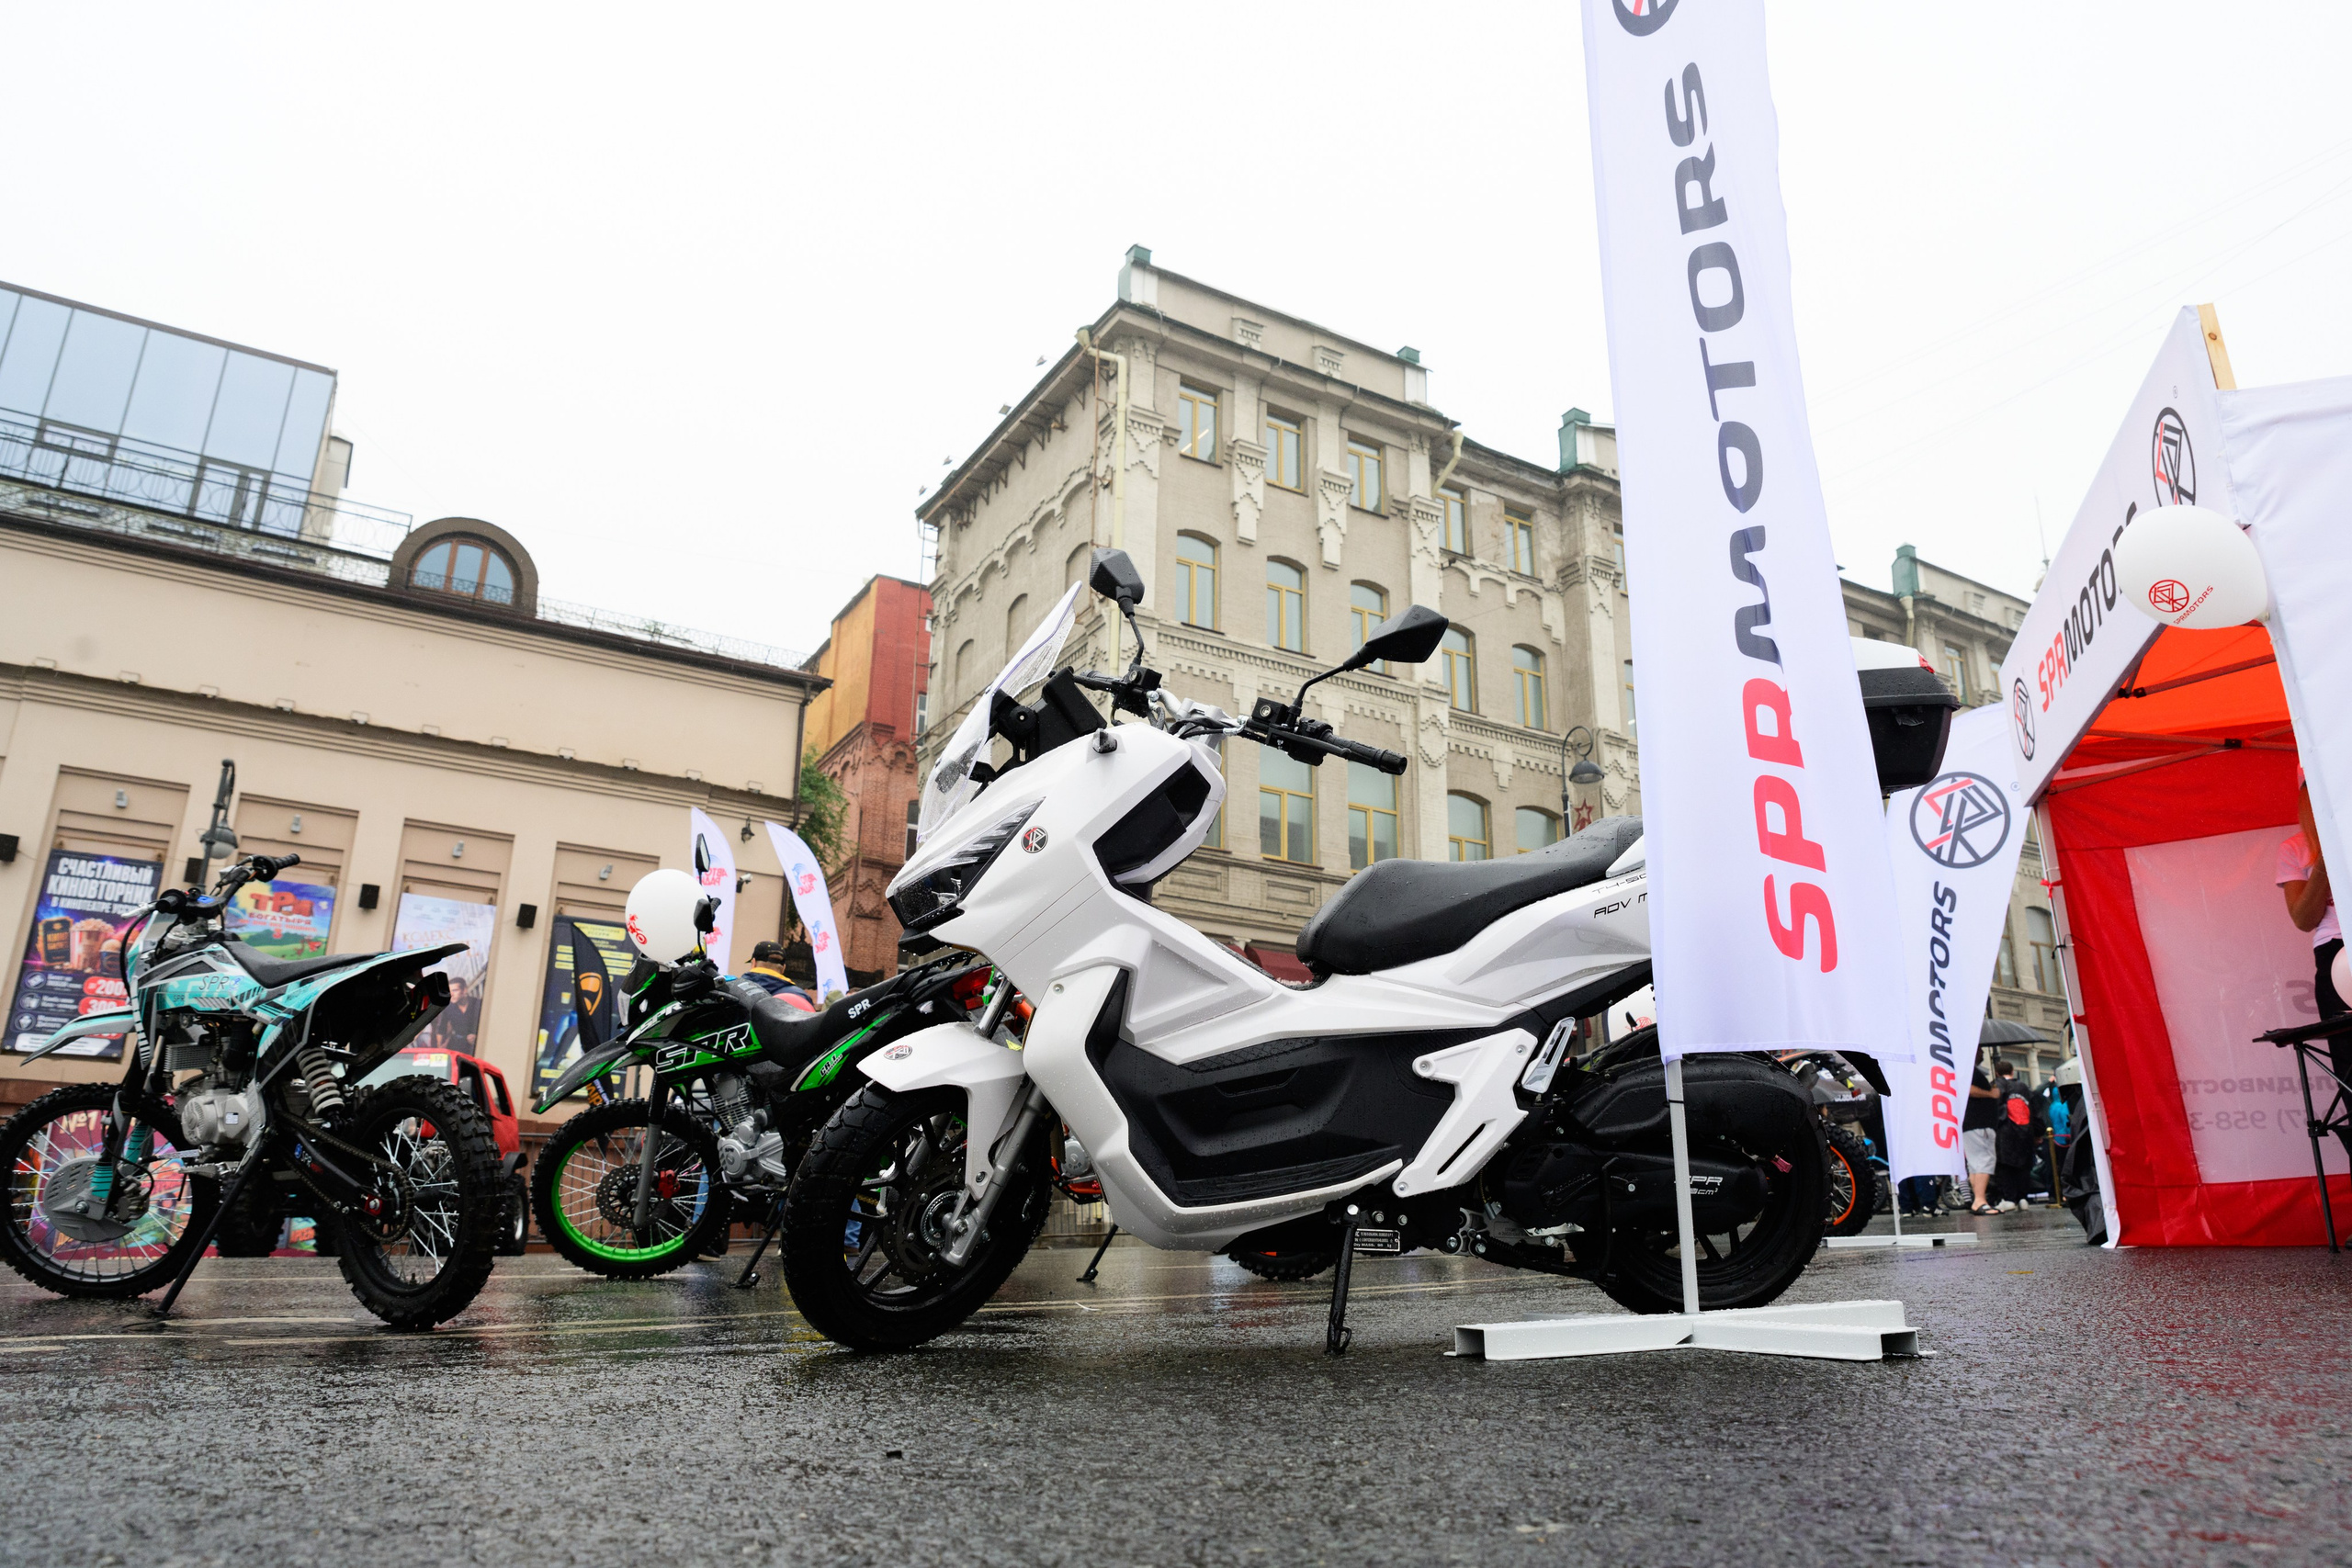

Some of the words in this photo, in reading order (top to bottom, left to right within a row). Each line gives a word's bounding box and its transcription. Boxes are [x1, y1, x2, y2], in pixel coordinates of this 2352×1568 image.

[1664, 62, 1838, 973] SPRMOTORS
[2173, 585, 2213, 625] SPRMOTORS
[57, 857, 154, 885] СЧАСТЛИВЫЙ
[47, 874, 155, 902] КИНОВТОРНИК
[250, 891, 315, 918] ТРИ
[1594, 897, 1632, 919] ADV
[249, 912, 312, 926] БОГАТЫРЯ
[198, 975, 230, 991] SPR
[848, 998, 871, 1019] SPR
[1928, 880, 1960, 1152] SPRMOTORS
[655, 1021, 751, 1074] SPR
[59, 1111, 99, 1134] №1
